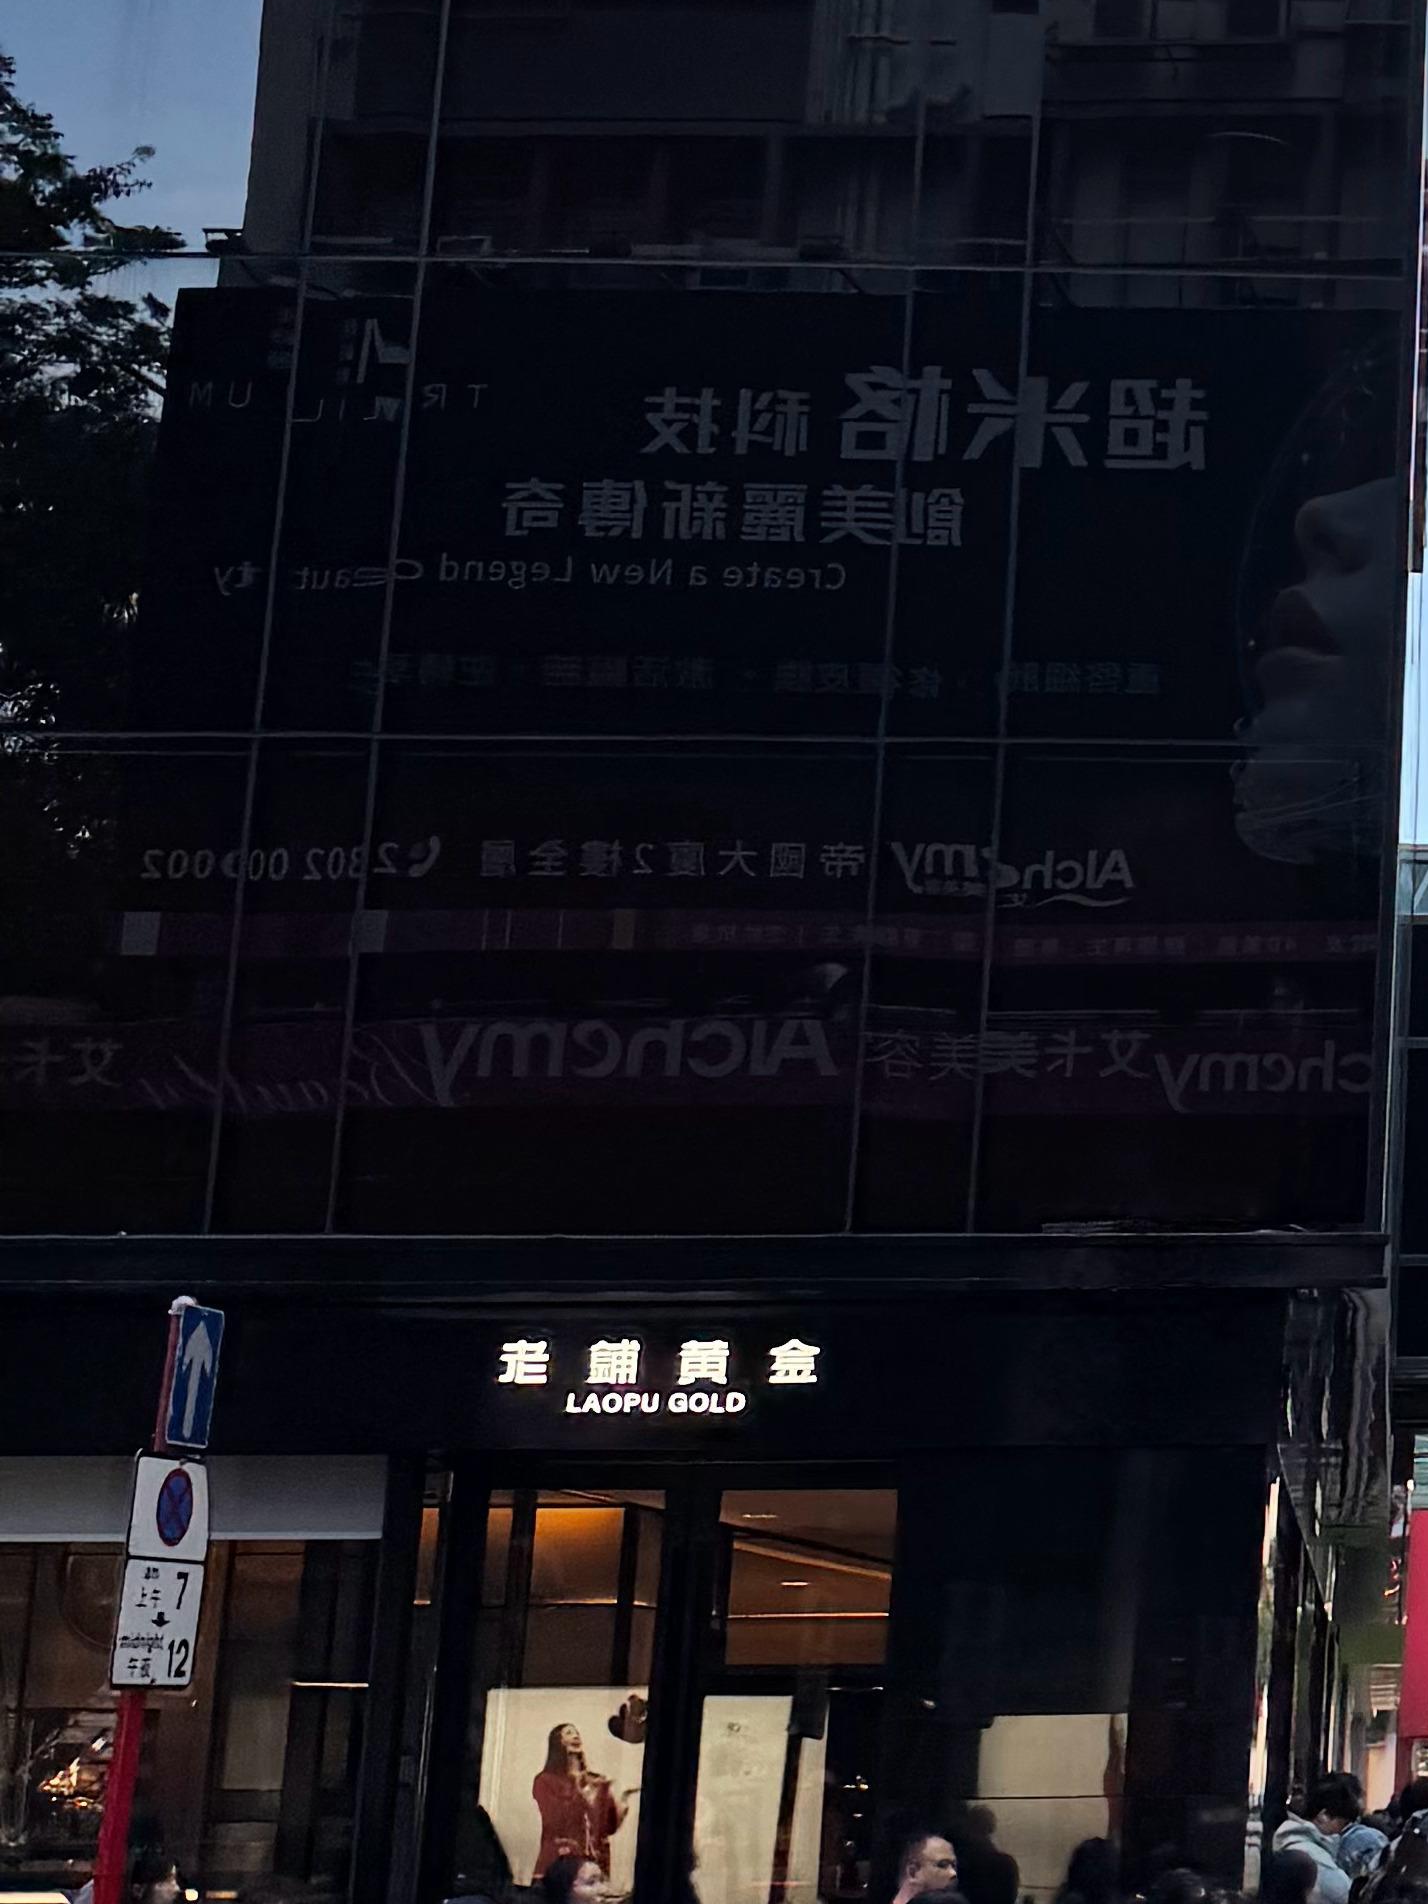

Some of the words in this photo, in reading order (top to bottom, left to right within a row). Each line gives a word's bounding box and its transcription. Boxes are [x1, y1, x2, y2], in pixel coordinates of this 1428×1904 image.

[566, 1393, 660, 1413] LAOPU
[668, 1392, 746, 1413] GOLD
[176, 1571, 190, 1610] 7
[168, 1638, 190, 1678] 12
